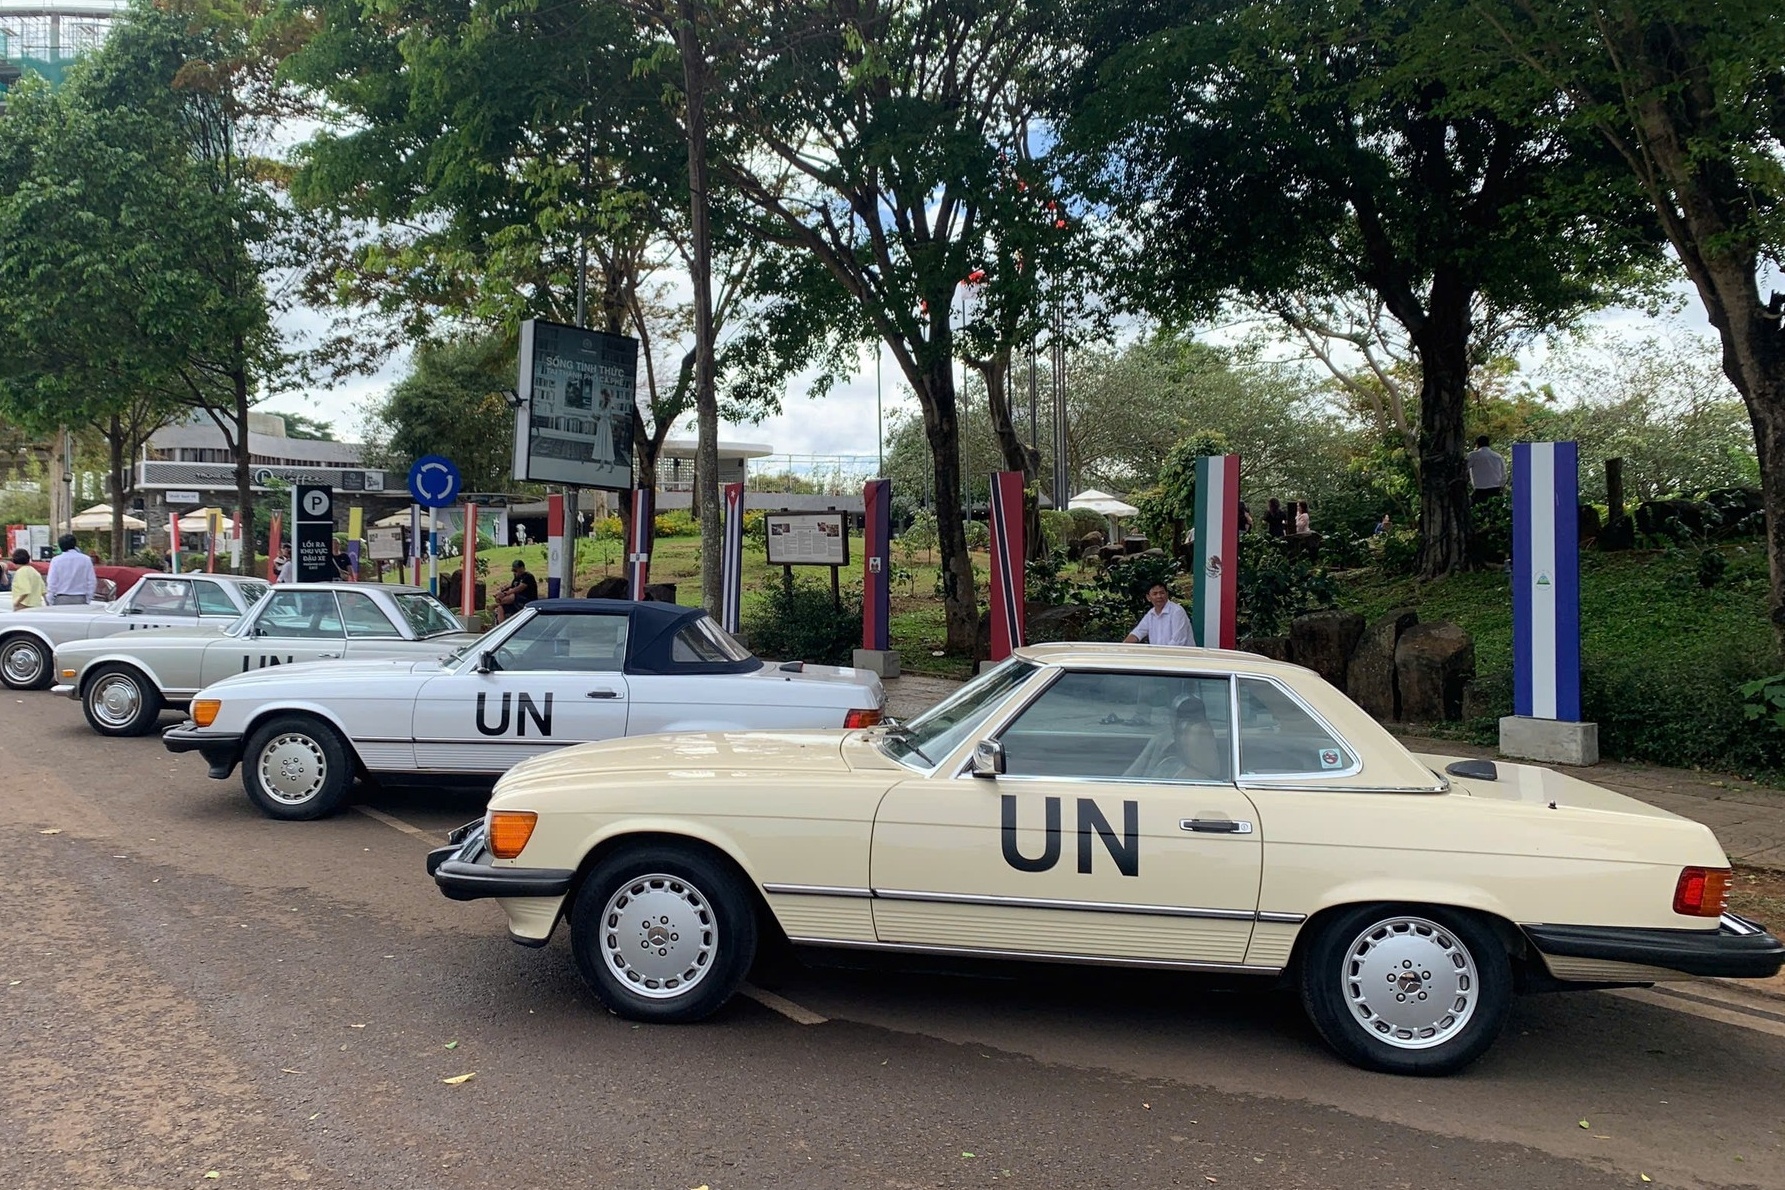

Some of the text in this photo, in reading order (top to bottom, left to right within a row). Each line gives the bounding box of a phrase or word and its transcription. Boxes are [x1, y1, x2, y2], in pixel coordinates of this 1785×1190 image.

[546, 355, 573, 369] SỐNG
[312, 496, 322, 510] P
[476, 692, 553, 736] UN
[1001, 795, 1139, 877] UN
